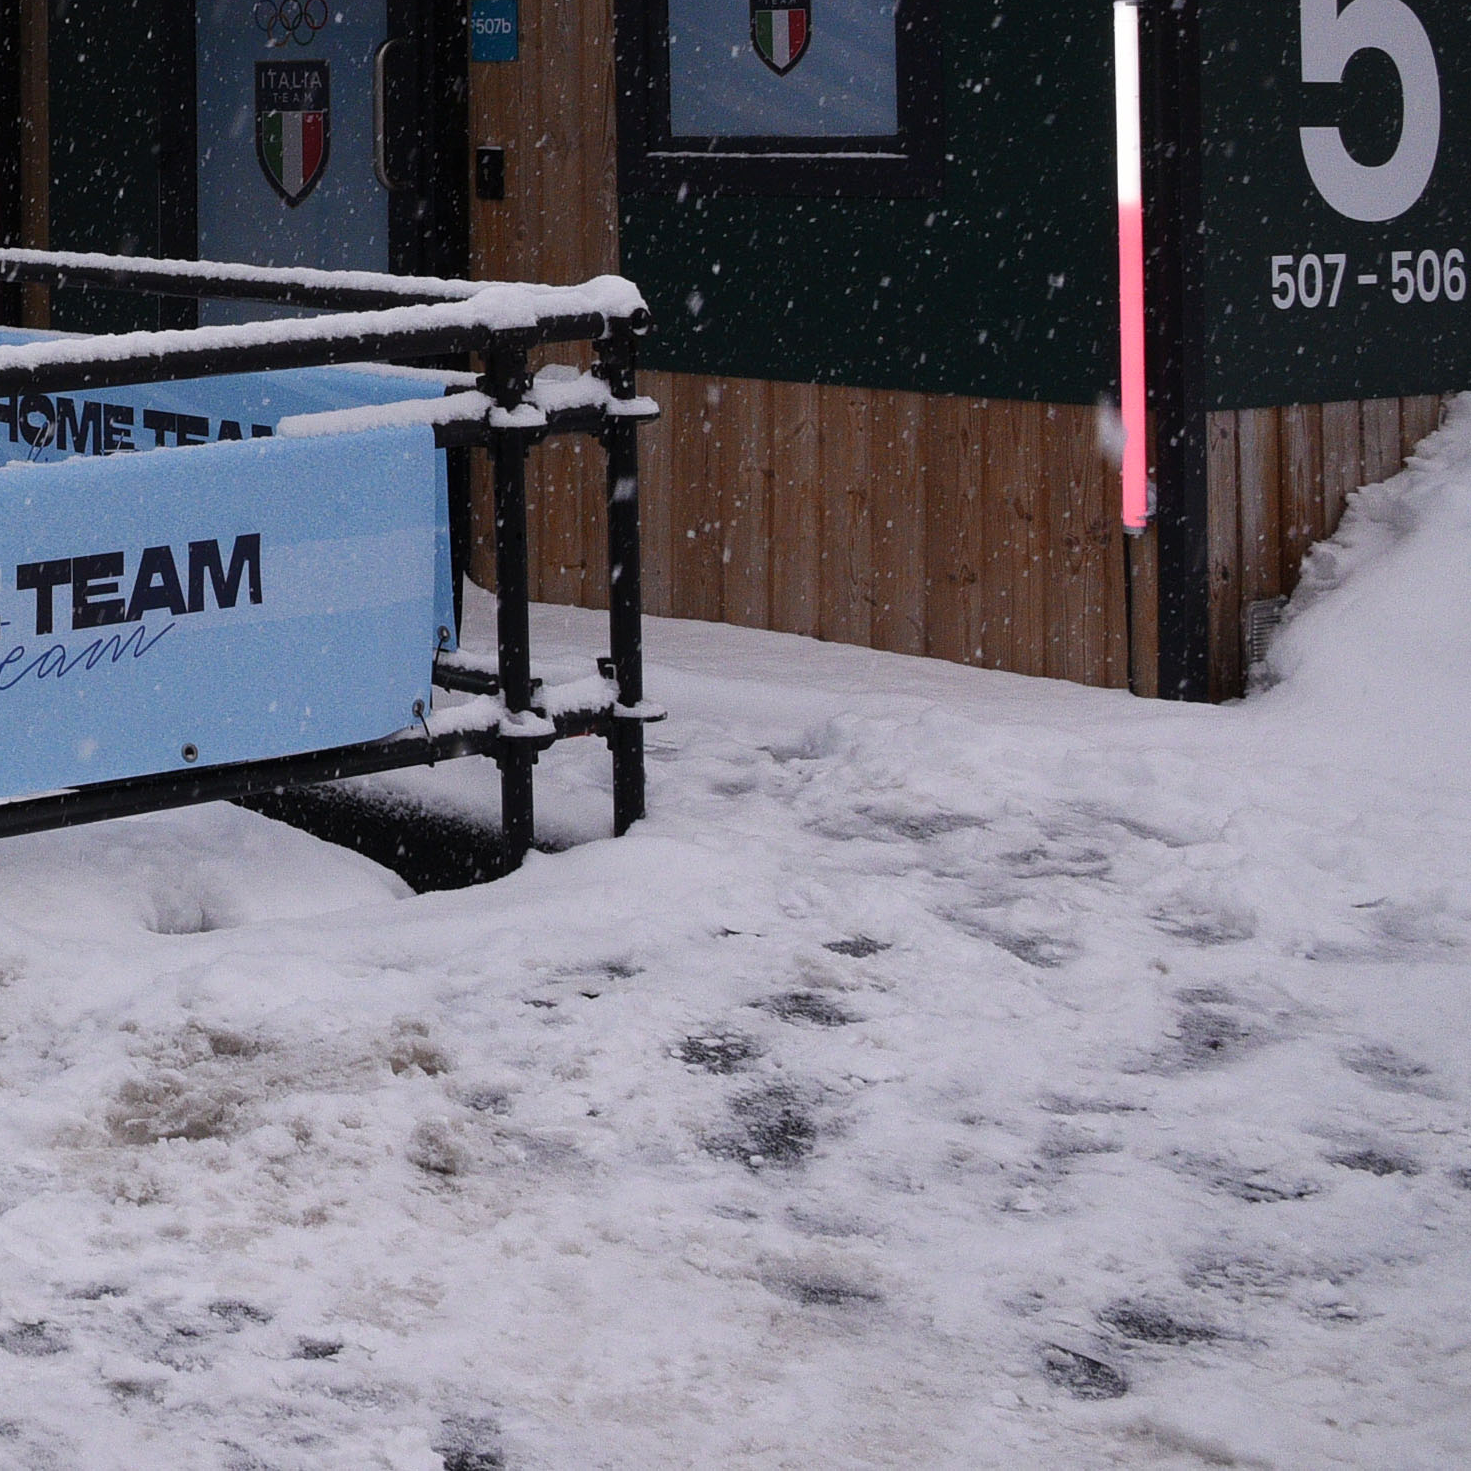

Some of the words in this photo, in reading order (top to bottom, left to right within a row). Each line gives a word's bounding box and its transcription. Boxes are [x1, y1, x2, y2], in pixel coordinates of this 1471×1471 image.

[475, 18, 512, 34] 507b
[260, 70, 323, 89] ITALIA
[273, 92, 314, 103] TEAM
[1271, 253, 1347, 310] 507
[1390, 248, 1466, 304] 506
[15, 533, 264, 636] TEAM
